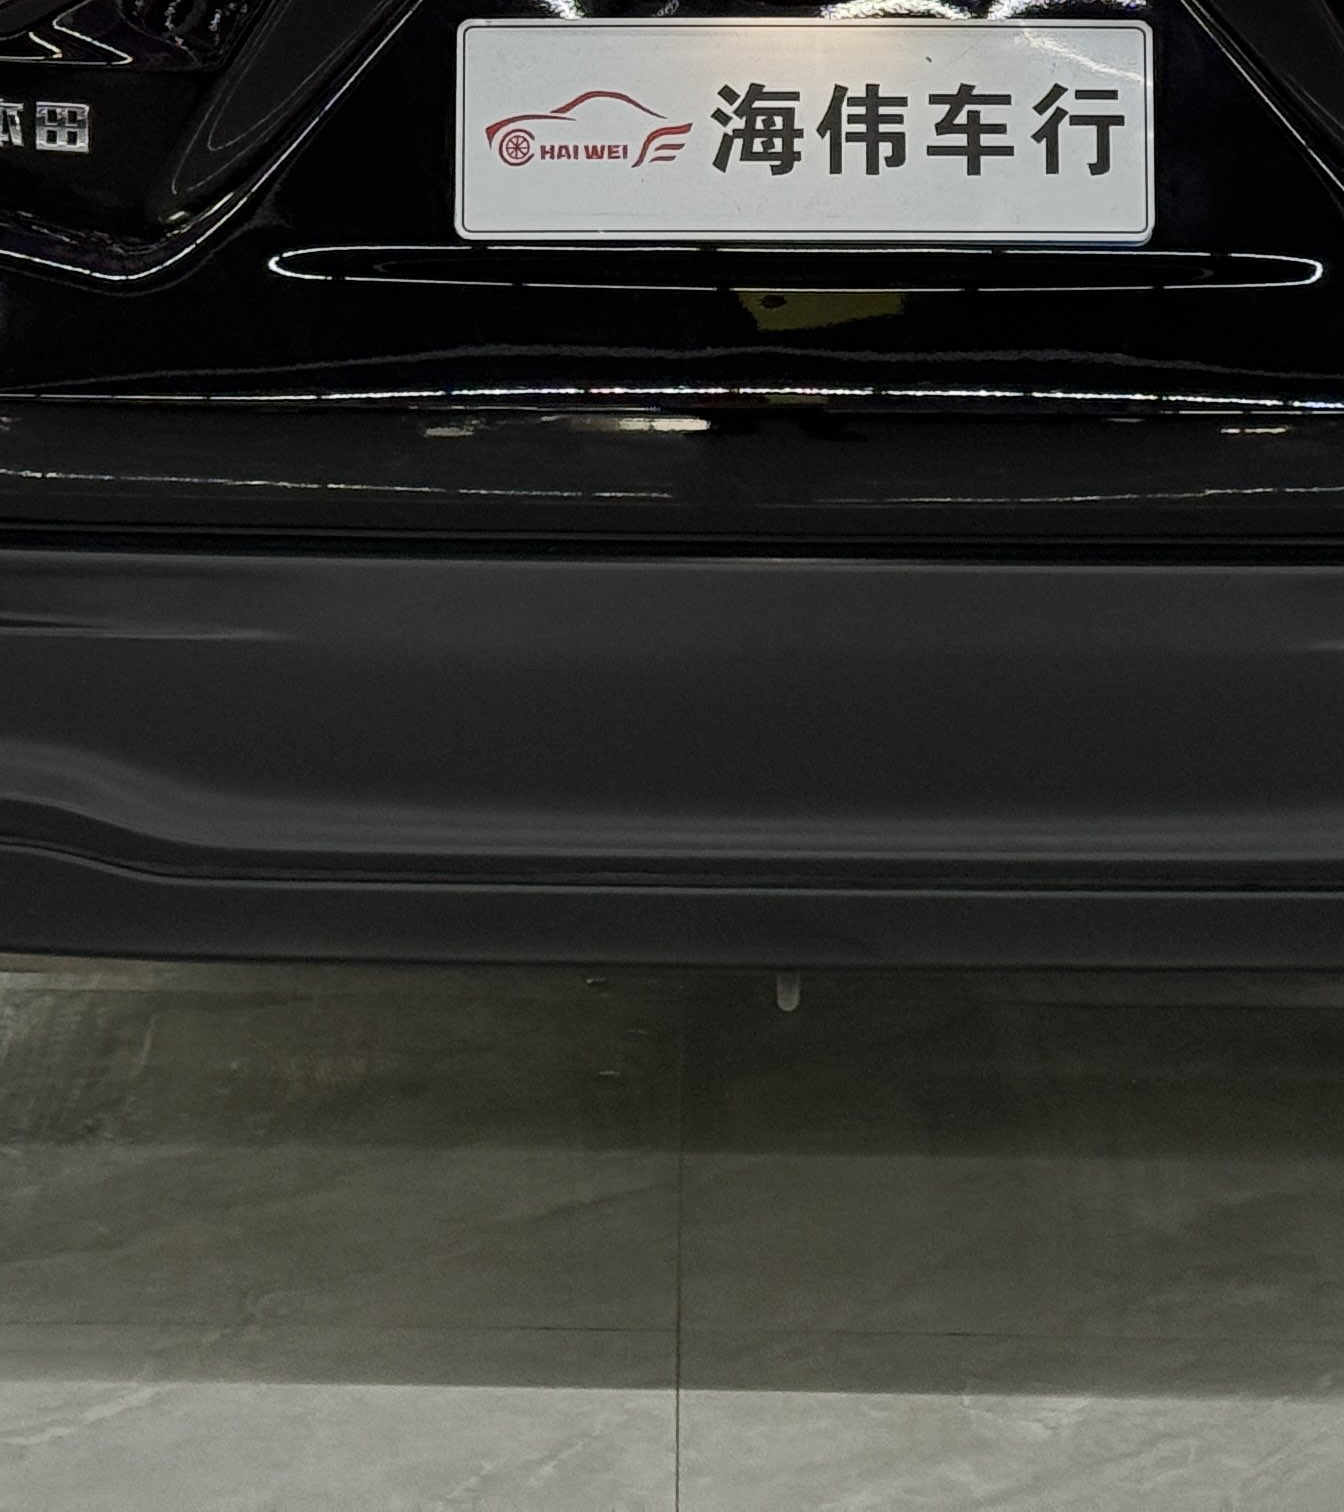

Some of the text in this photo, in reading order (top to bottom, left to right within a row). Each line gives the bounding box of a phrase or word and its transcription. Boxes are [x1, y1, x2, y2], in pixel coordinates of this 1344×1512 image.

[539, 144, 629, 161] HAI WEI
[709, 82, 1126, 177] 海伟车行
